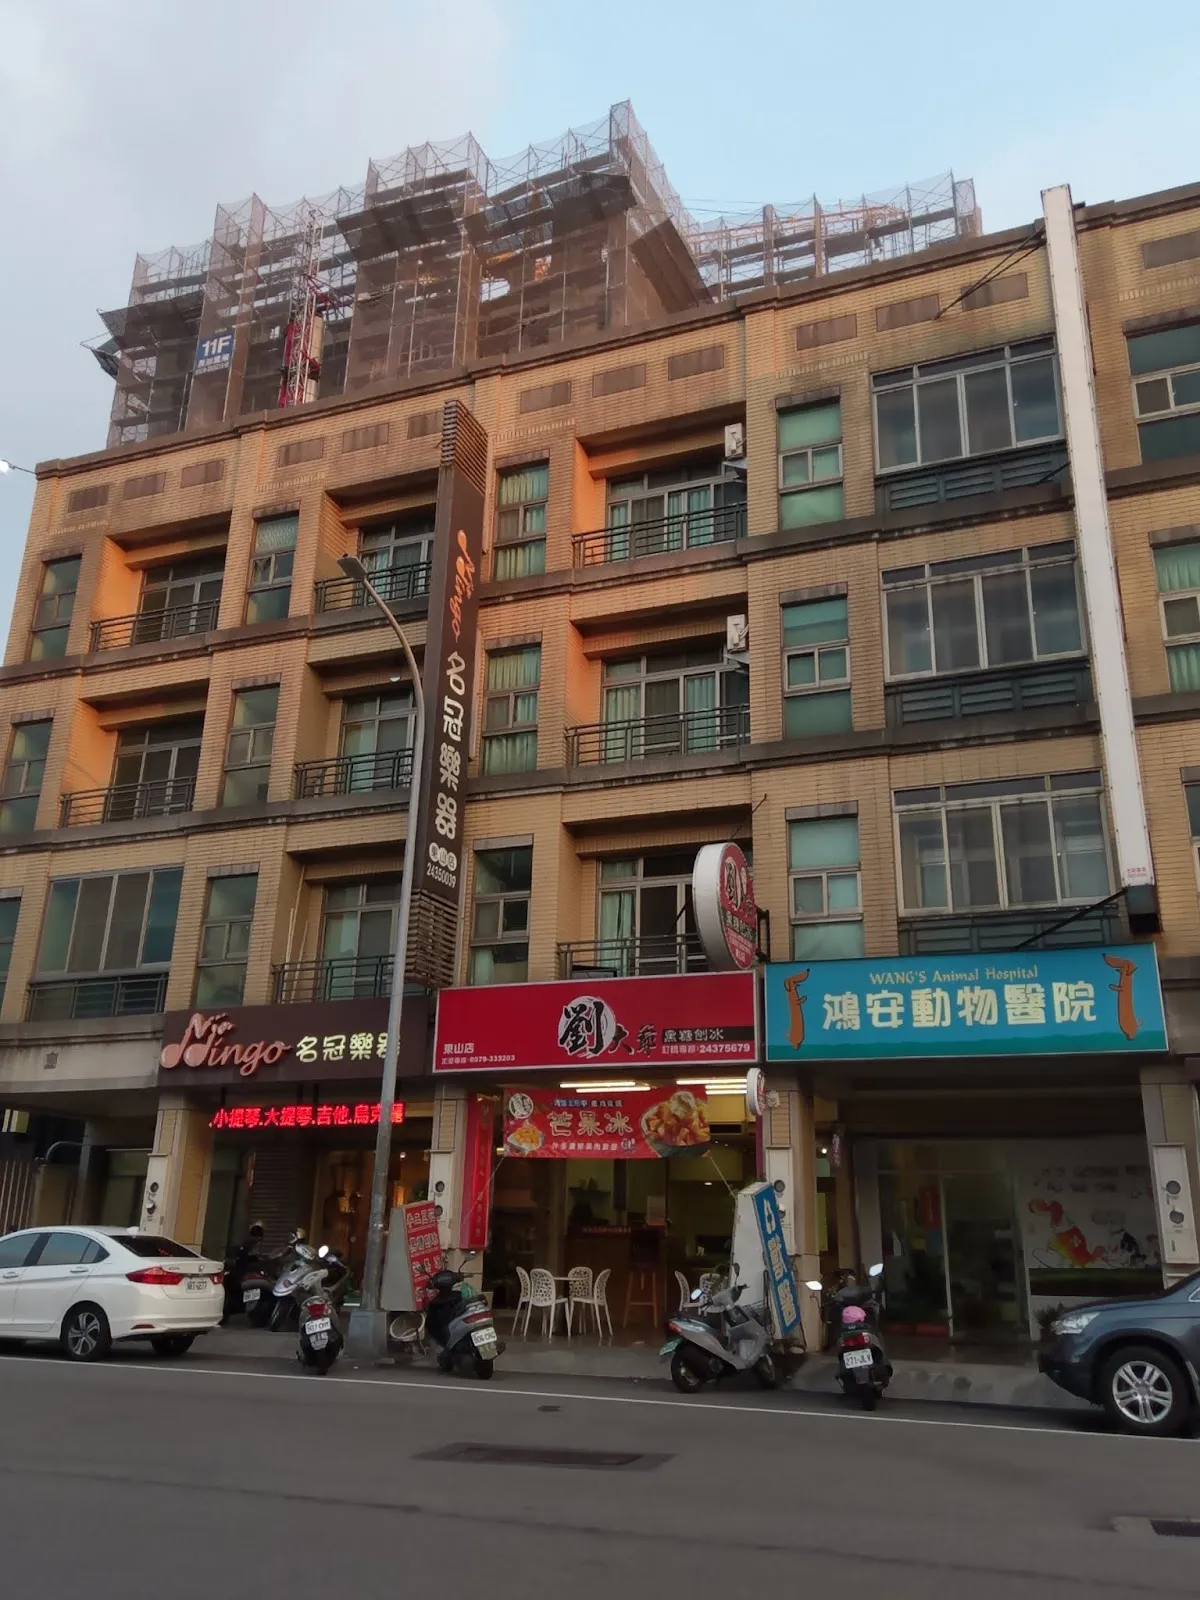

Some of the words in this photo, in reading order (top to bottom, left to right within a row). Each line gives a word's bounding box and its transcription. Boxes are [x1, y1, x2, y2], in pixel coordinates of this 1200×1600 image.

[202, 335, 232, 356] 11F
[435, 651, 466, 840] 名冠樂器
[869, 970, 927, 985] WANG'S
[932, 968, 979, 983] Animal
[985, 964, 1039, 983] Hospital
[822, 980, 1098, 1032] 鴻安動物醫院
[443, 1042, 475, 1054] 東山店
[546, 1110, 634, 1137] 芒果冰
